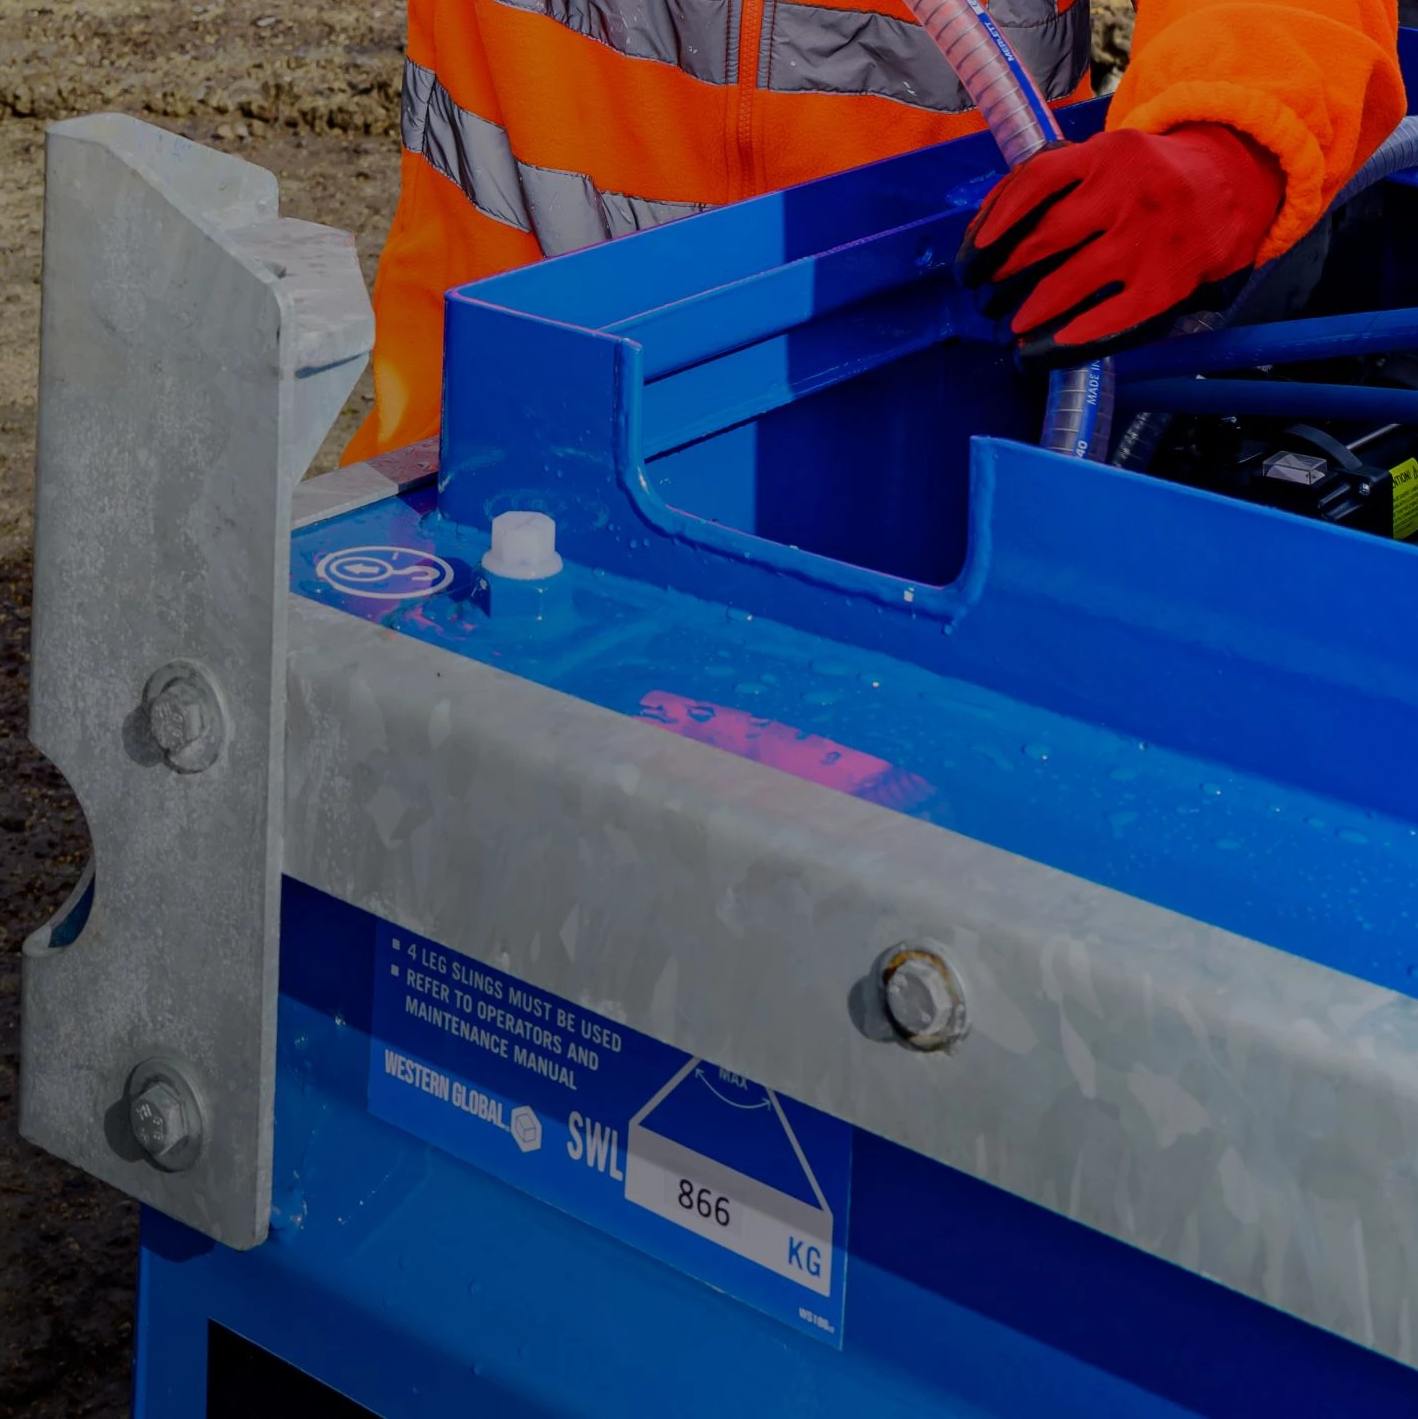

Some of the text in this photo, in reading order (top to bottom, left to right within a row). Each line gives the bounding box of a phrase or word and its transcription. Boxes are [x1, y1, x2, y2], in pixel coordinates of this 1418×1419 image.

[984, 21, 1014, 62] MERLETT
[1087, 373, 1100, 406] MADE
[406, 995, 578, 1091] MAINTENANCE MANUAL
[407, 944, 622, 1053] 4 LEG SLINGS MUST BE USED
[407, 968, 599, 1071] REFER TO OPERATORS AND
[384, 1049, 449, 1102] WESTERN
[567, 1110, 821, 1279] SWL 866 KG
